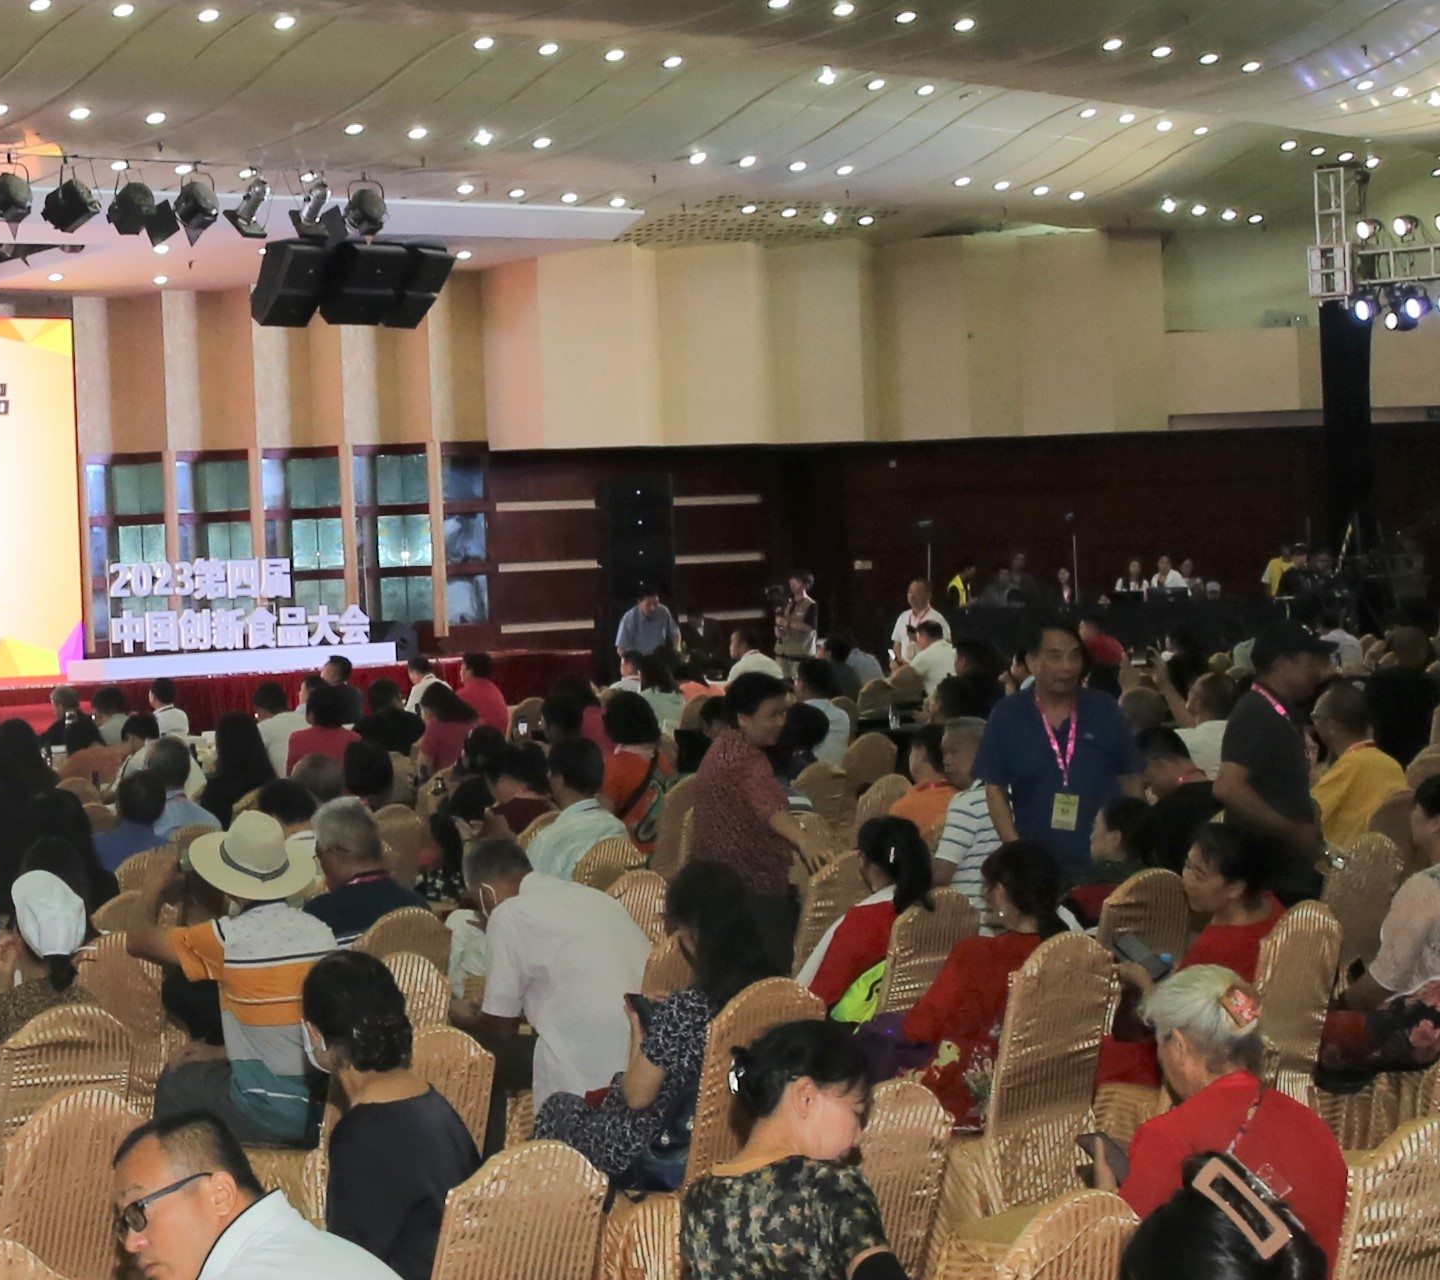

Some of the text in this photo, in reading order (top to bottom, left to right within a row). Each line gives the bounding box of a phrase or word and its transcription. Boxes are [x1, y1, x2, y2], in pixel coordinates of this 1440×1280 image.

[109, 556, 292, 600] 2023第四届
[110, 604, 371, 653] 中国创新食品大会
